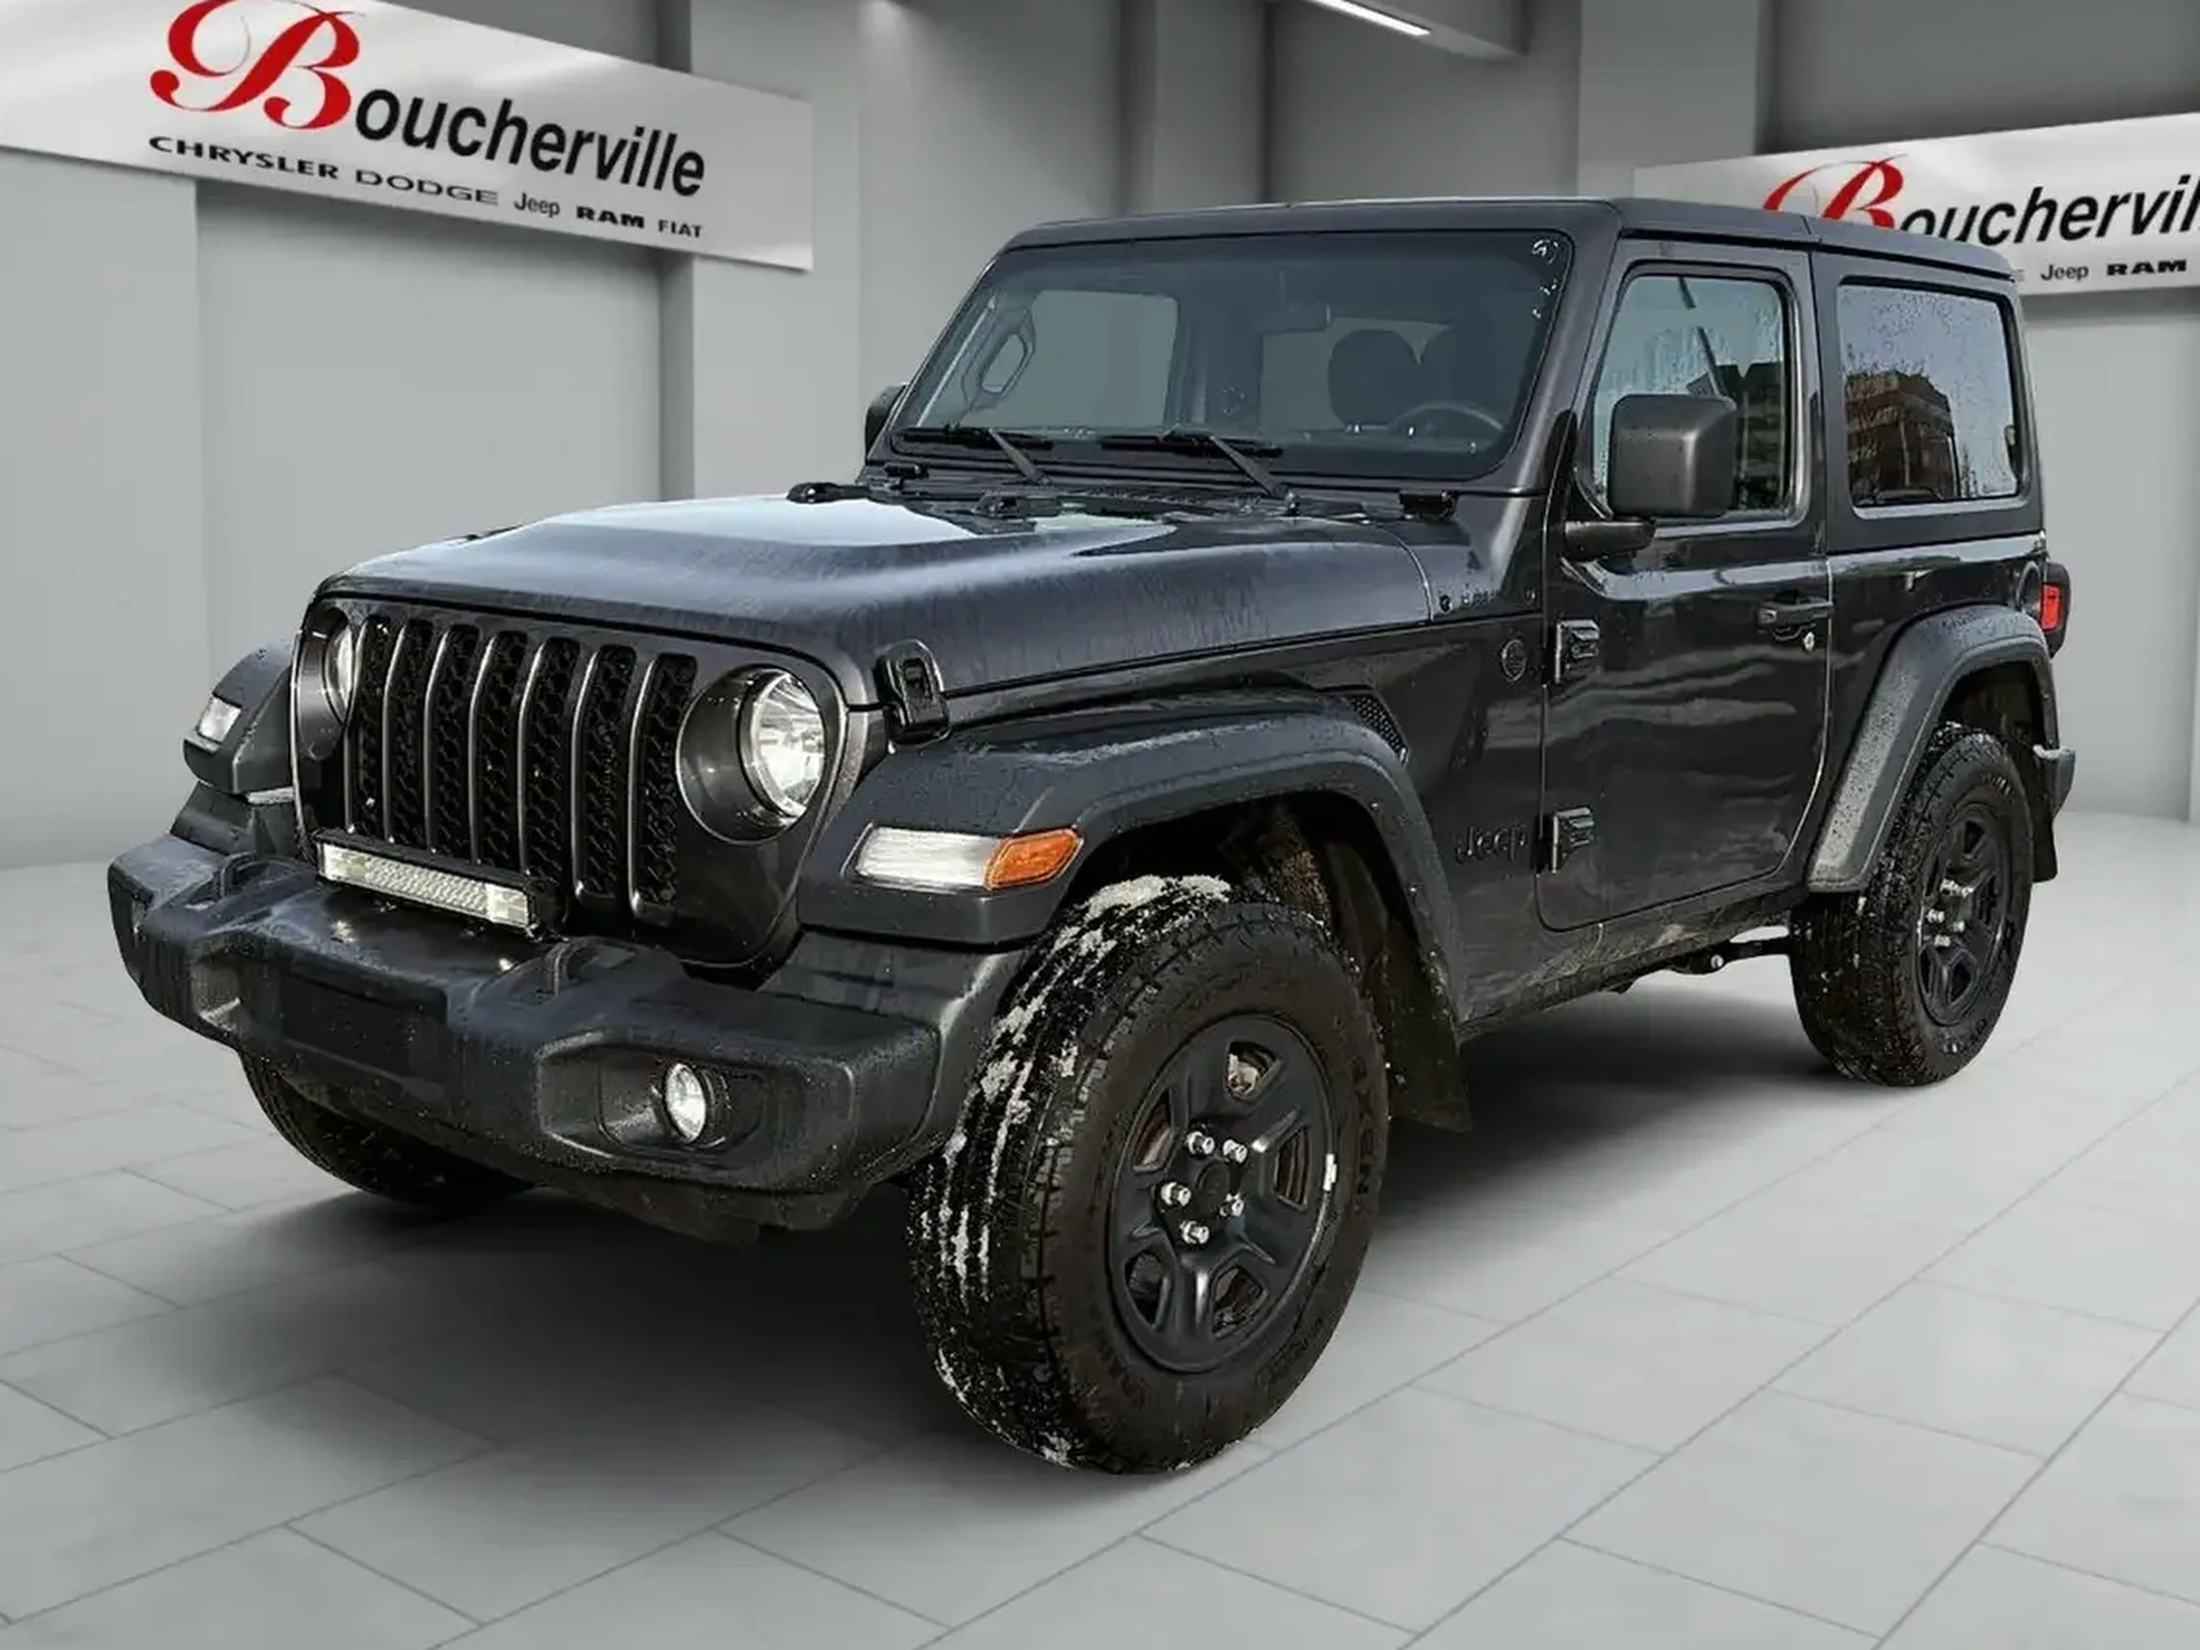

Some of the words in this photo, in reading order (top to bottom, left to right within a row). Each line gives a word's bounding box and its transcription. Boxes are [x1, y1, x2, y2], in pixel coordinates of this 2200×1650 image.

[149, 0, 705, 198] Boucherville
[148, 136, 339, 180] CHRYSLER
[355, 169, 498, 205] DODGE
[514, 192, 560, 218] Jeep
[576, 205, 645, 229] RAM
[657, 218, 702, 239] FIAT
[2040, 263, 2090, 283] Jeep
[2106, 258, 2188, 277] RAM
[1456, 824, 1528, 864] Jeep
